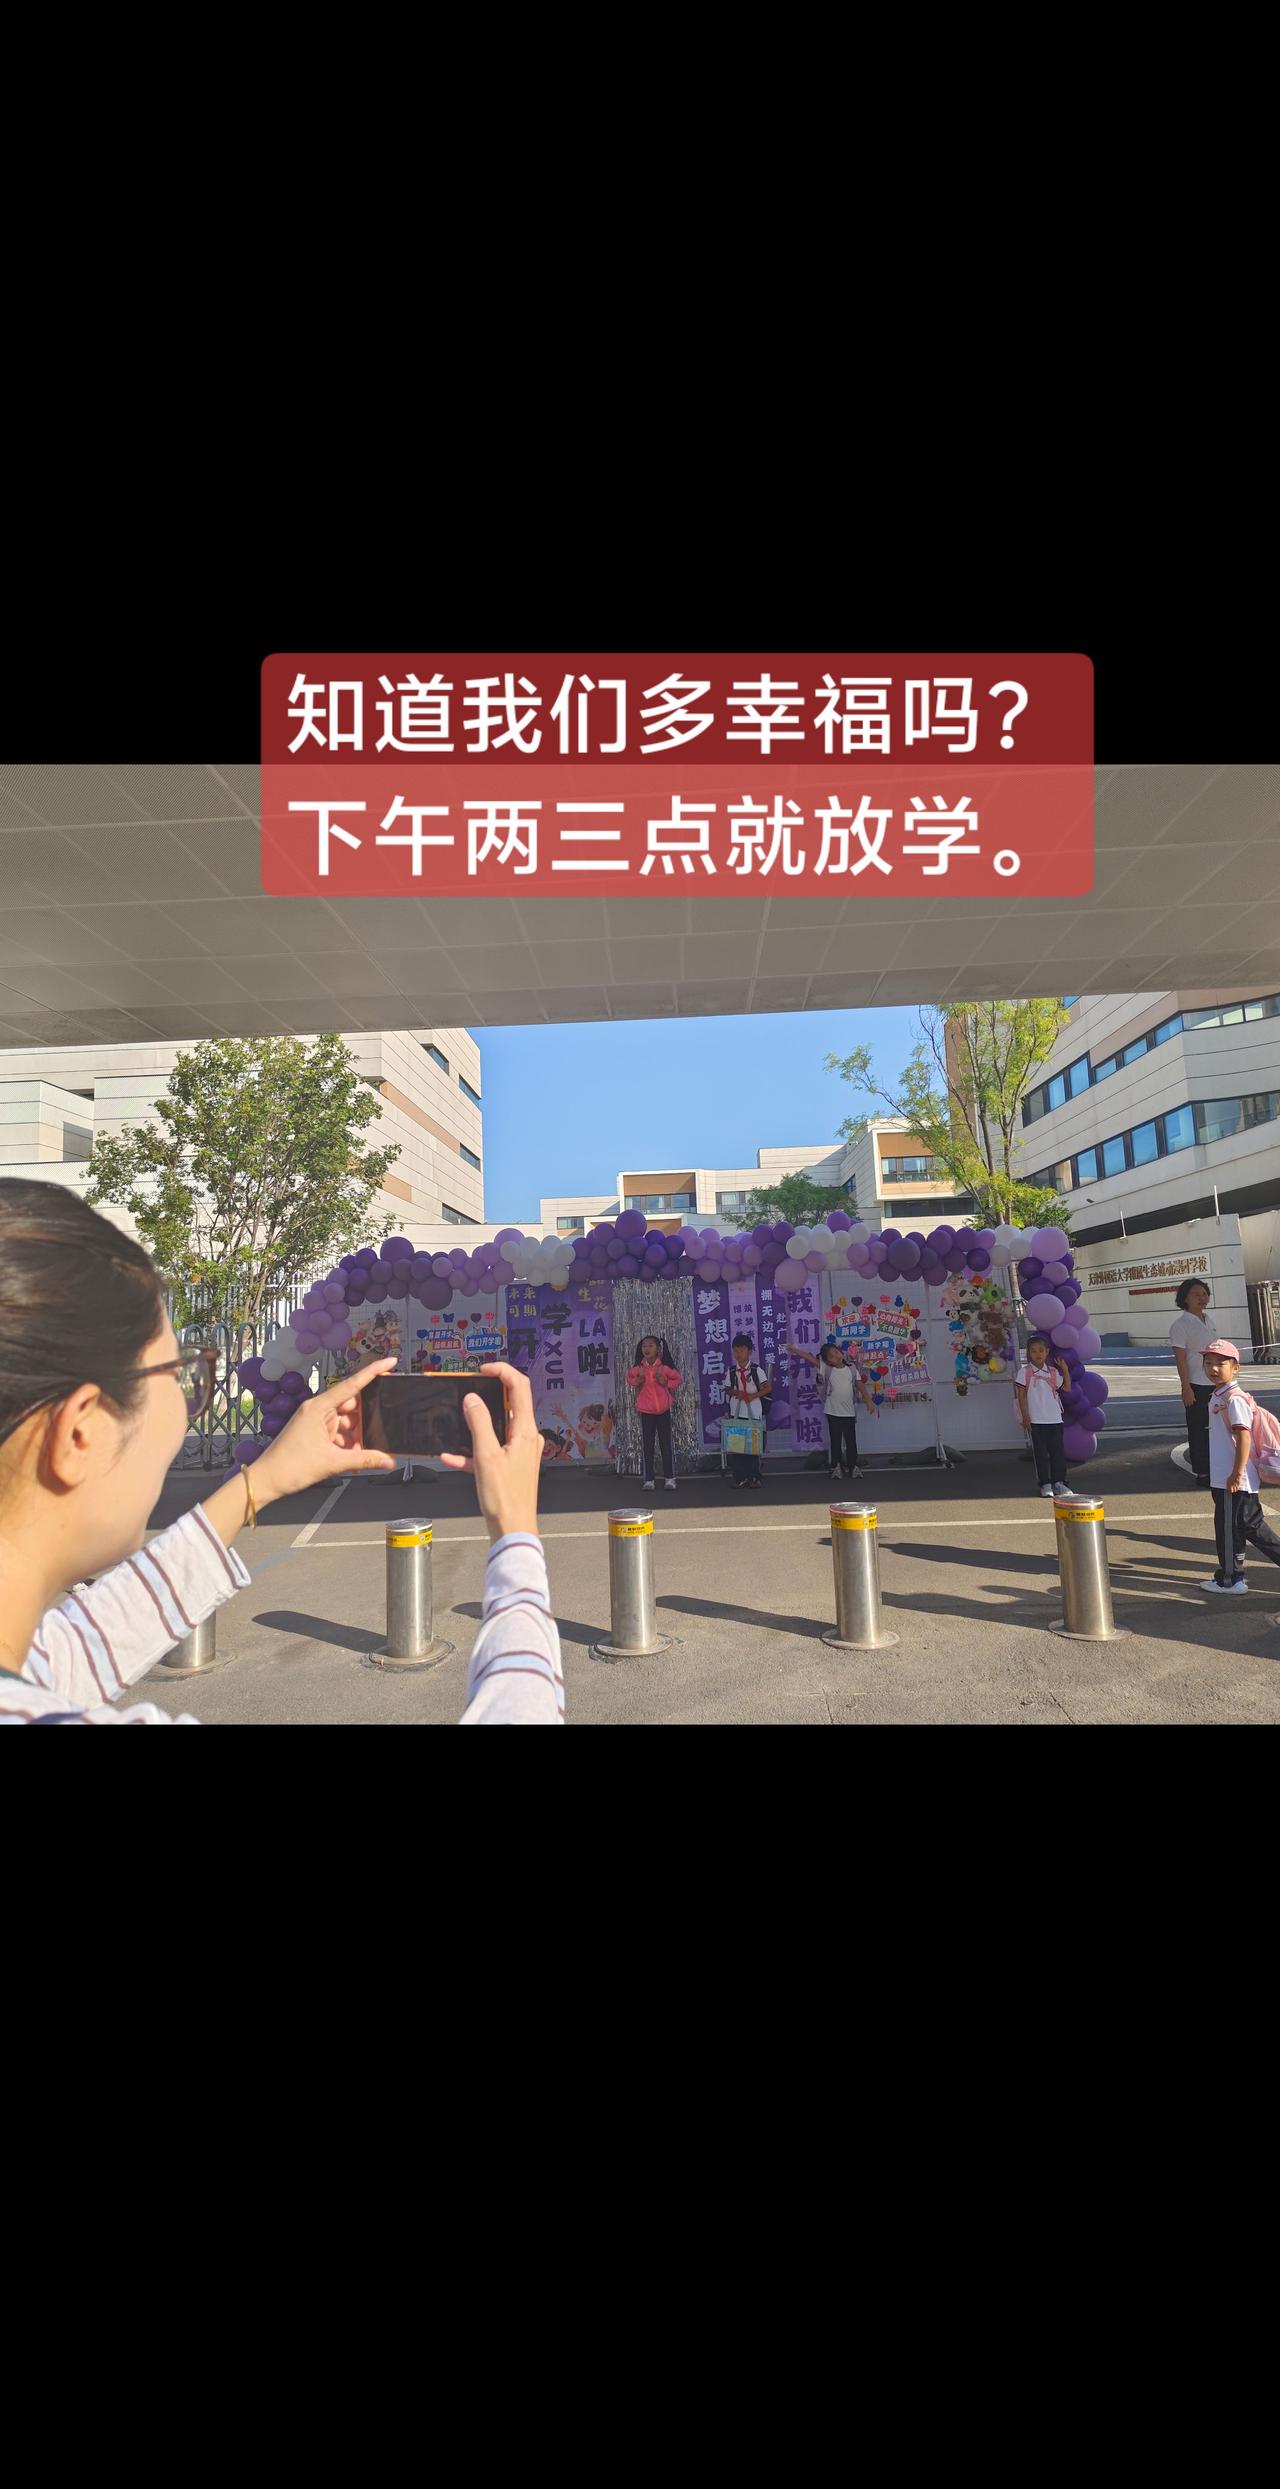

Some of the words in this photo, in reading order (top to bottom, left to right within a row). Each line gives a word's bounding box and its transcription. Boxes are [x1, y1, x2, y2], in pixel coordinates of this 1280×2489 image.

[579, 1318, 607, 1338] LA
[841, 1325, 867, 1336] 新同学
[696, 1289, 730, 1406] 梦想启航
